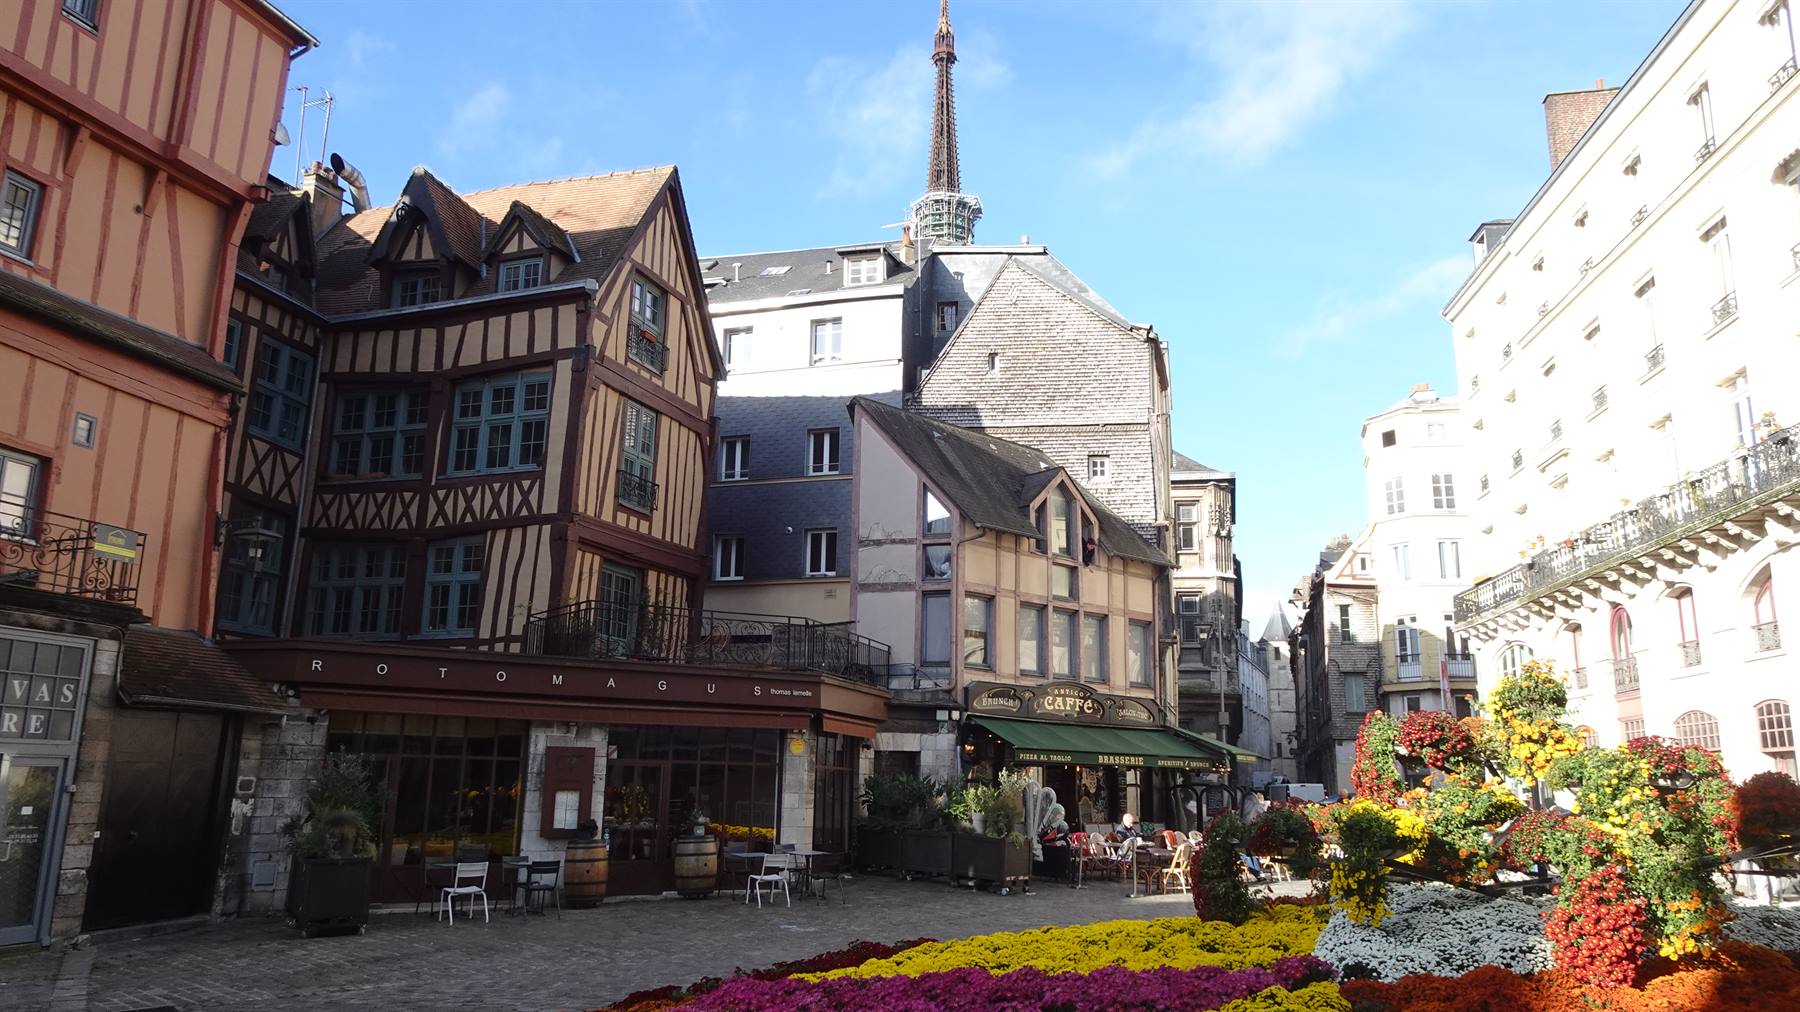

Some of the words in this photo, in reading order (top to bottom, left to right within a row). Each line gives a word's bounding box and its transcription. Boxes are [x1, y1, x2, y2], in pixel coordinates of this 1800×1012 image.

[1055, 688, 1084, 697] ANTICO
[982, 697, 1014, 707] BRUNCH
[1098, 754, 1145, 766] BRASSERIE
